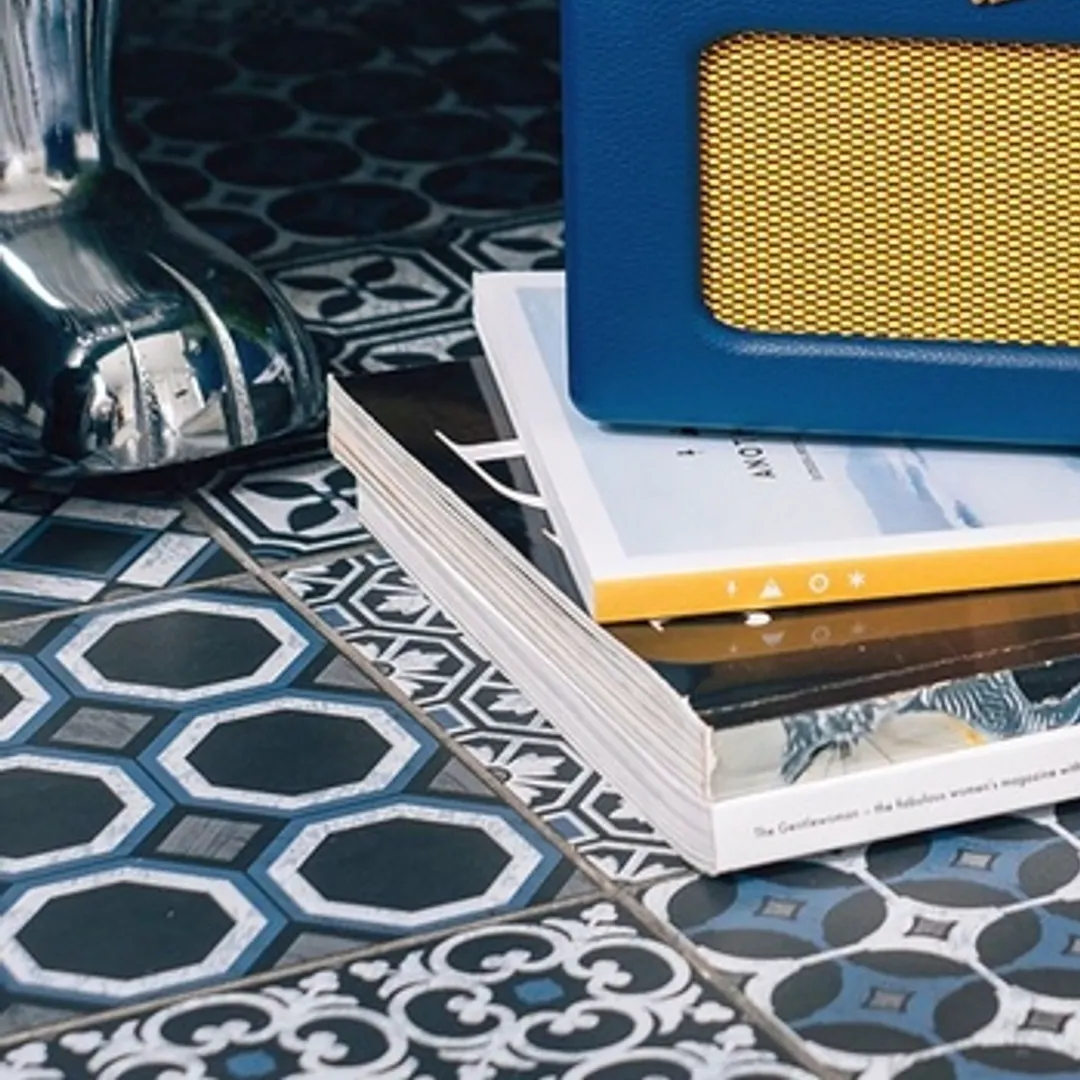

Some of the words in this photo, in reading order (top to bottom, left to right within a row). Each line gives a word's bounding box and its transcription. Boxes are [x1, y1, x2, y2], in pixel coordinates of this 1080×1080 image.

[753, 826, 776, 838] The
[873, 802, 894, 814] the
[999, 768, 1058, 788] magazine
